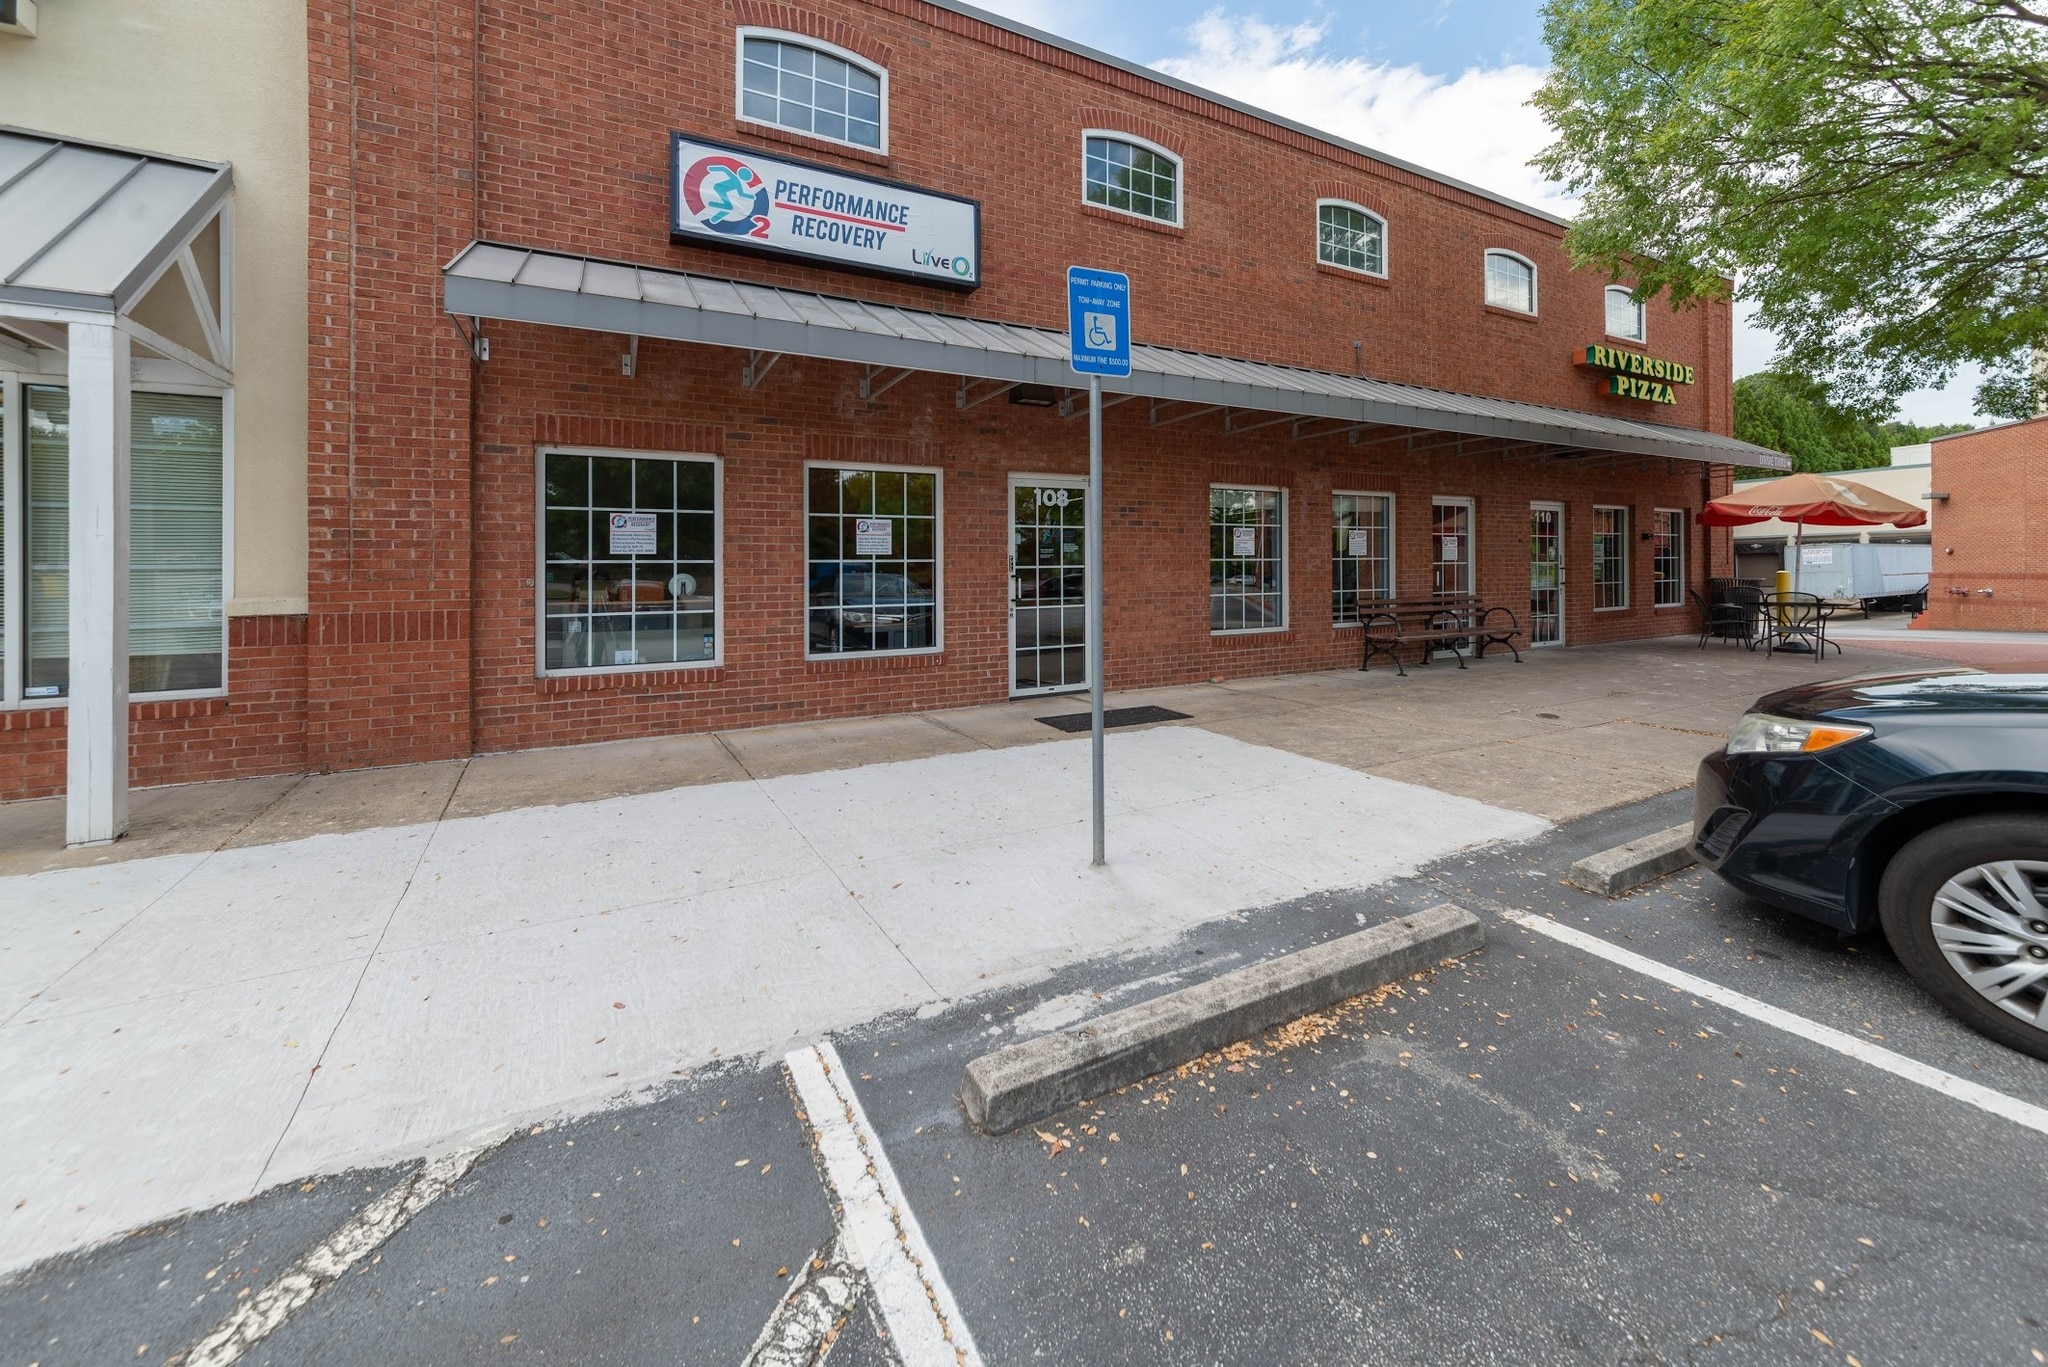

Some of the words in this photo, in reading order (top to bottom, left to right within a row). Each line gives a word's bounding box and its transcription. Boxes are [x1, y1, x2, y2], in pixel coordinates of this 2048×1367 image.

[774, 179, 910, 226] PERFORMANCE
[791, 214, 887, 251] RECOVERY
[1070, 276, 1089, 286] PERMIT
[1090, 279, 1113, 290] PARKING
[1113, 282, 1127, 291] ONLY
[1077, 295, 1106, 306] TOW-AWAY
[1106, 299, 1121, 308] ZONE
[1073, 354, 1097, 363] MAXIMUM
[1097, 356, 1108, 365] FINE
[1109, 357, 1129, 366] $500.00
[1594, 344, 1695, 385] RIVERSIDE
[1616, 374, 1677, 405] PIZZA
[1033, 487, 1069, 507] 108
[1535, 511, 1551, 523] 110
